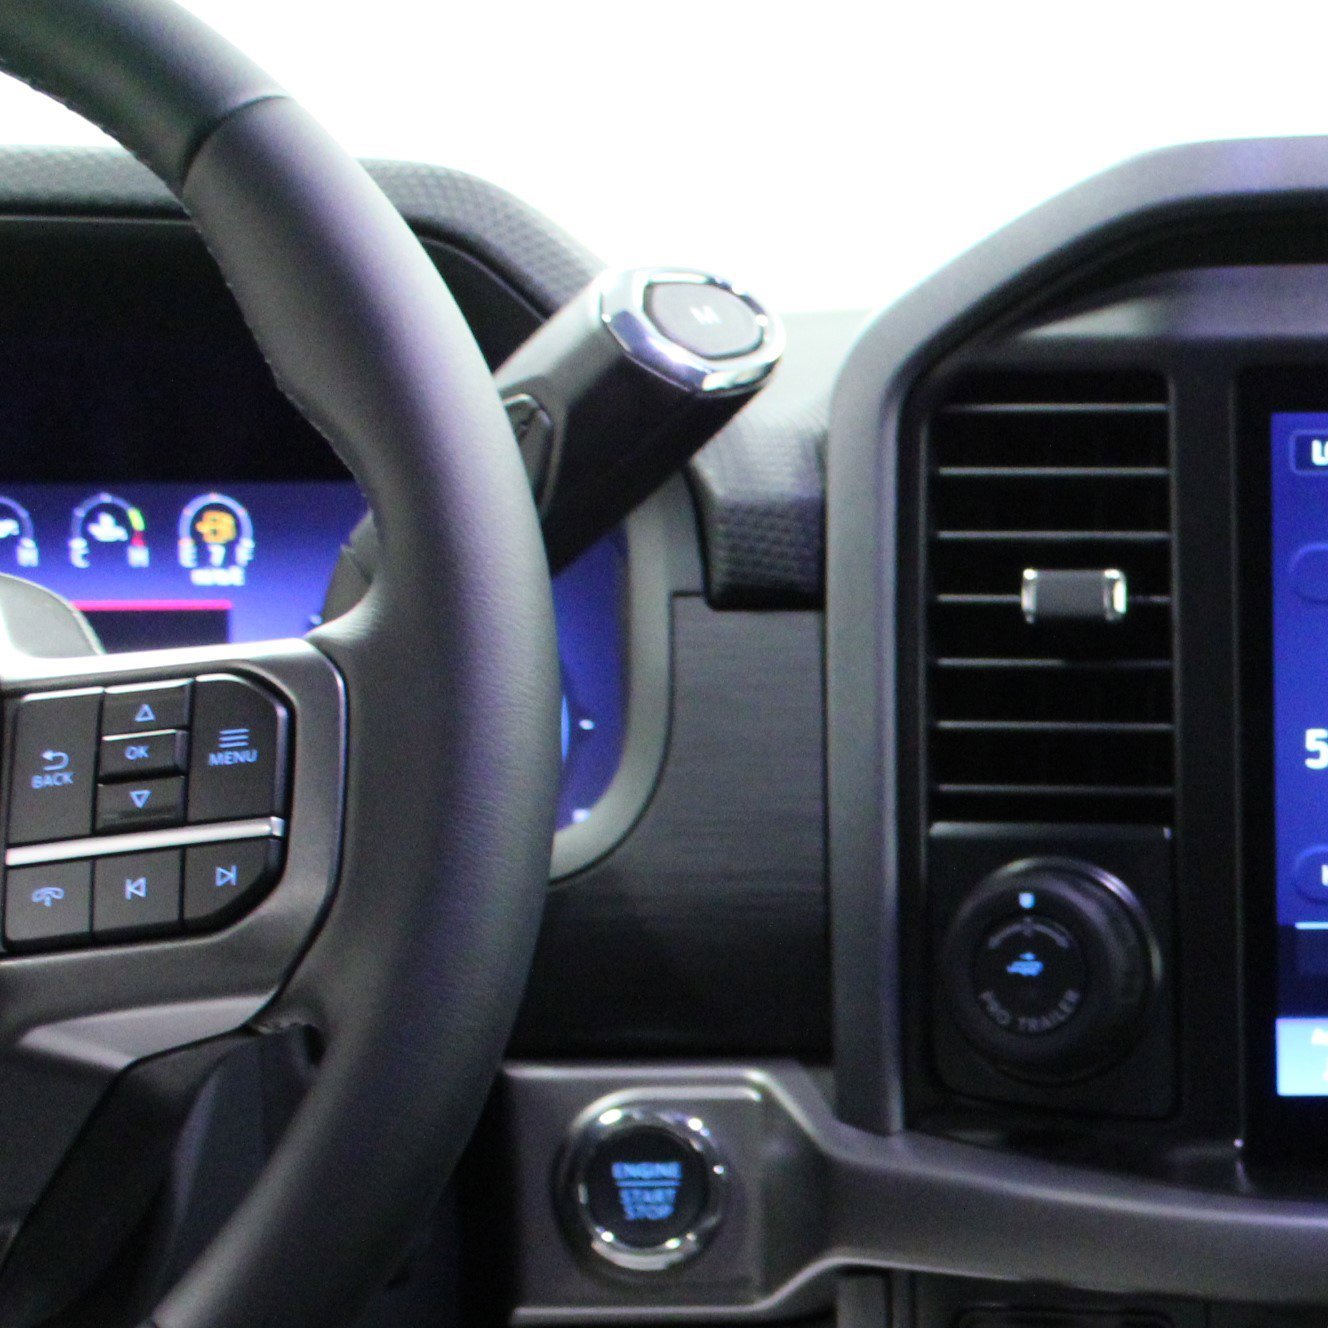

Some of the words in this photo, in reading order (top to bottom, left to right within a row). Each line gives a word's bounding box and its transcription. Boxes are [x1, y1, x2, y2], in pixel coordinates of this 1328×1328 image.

[125, 745, 149, 761] OK
[209, 750, 258, 767] MENU
[31, 773, 74, 789] BACK
